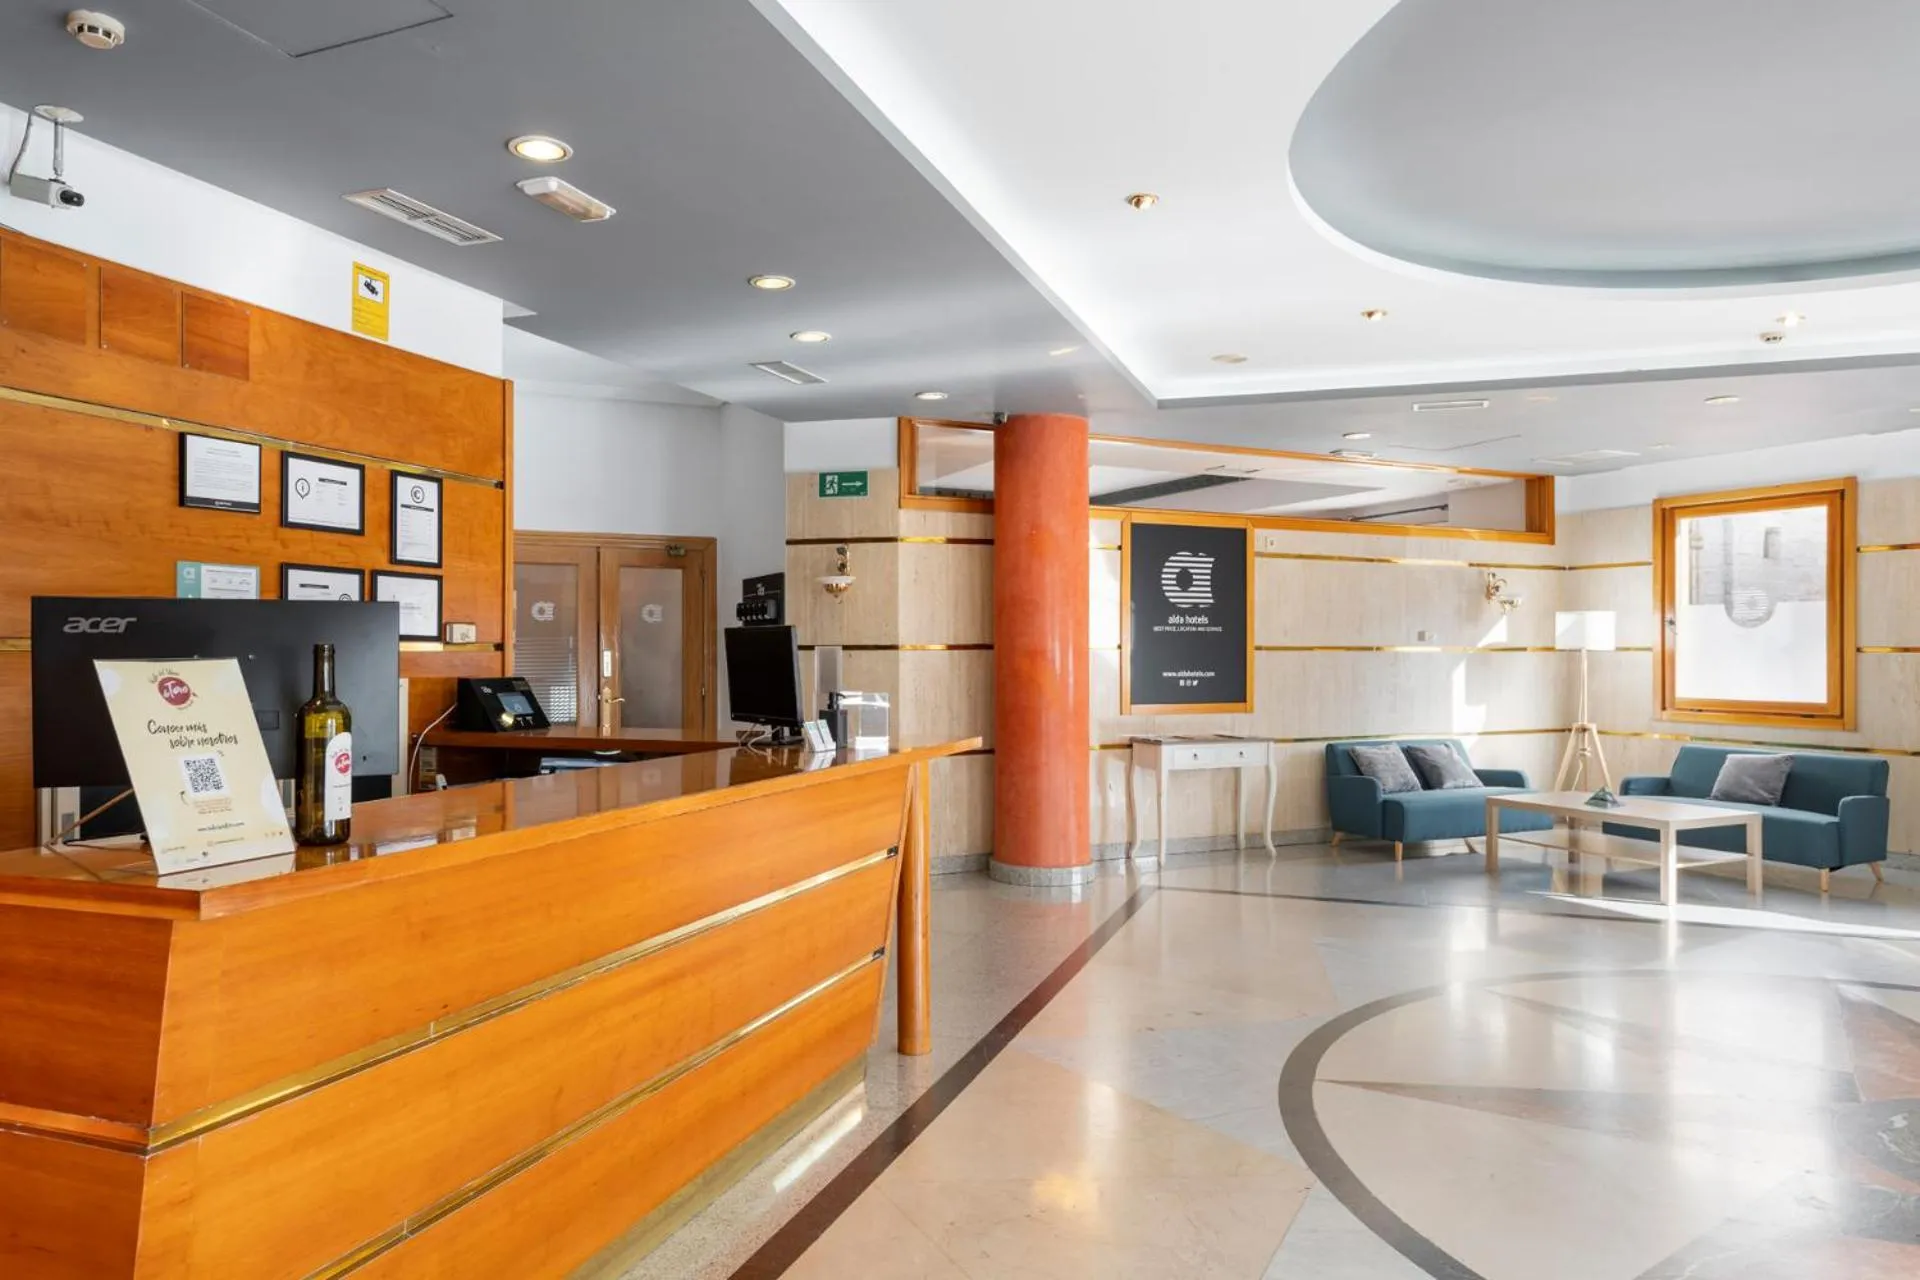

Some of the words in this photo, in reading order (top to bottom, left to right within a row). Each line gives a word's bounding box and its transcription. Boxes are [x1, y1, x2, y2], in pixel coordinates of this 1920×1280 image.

[63, 617, 138, 633] acer
[1167, 614, 1184, 624] alda
[1185, 614, 1209, 624] hotels
[1162, 669, 1215, 677] www.aldahotels.com
[147, 719, 184, 735] Conoce
[169, 735, 195, 749] sobre
[196, 732, 239, 747] nosotros
